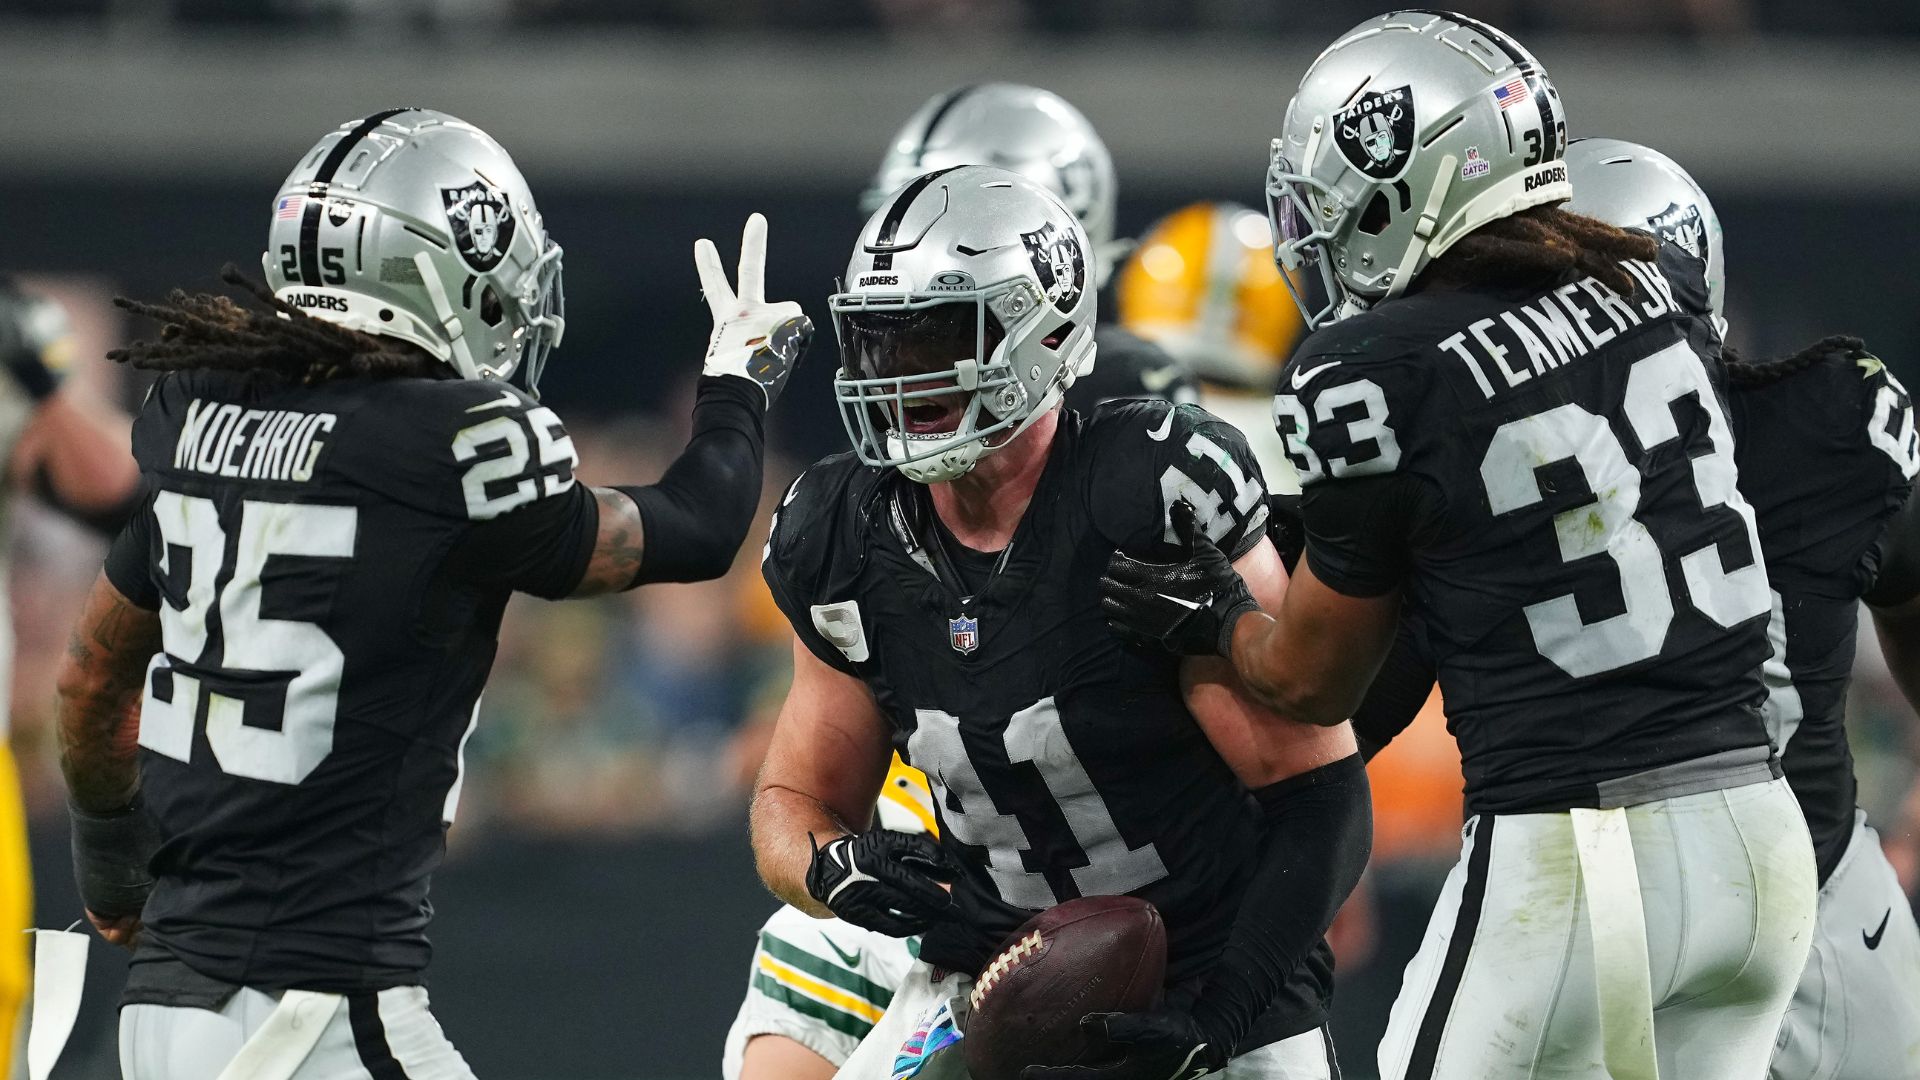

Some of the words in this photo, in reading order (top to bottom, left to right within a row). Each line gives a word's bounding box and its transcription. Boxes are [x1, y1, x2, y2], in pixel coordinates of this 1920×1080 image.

[1463, 163, 1489, 176] CATCH
[1524, 167, 1566, 193] RAIDERS
[287, 293, 349, 313] RAIDERS
[858, 275, 899, 288] RAIDERS
[1438, 276, 1642, 400] TEAMER
[174, 399, 337, 482] MOEHRIG
[451, 406, 579, 520] 25
[1272, 379, 1402, 488] 33
[1160, 432, 1264, 546] 41
[1480, 339, 1772, 679] 33
[137, 489, 358, 786] 25
[955, 633, 974, 648] NFL
[907, 696, 1170, 910] 41
